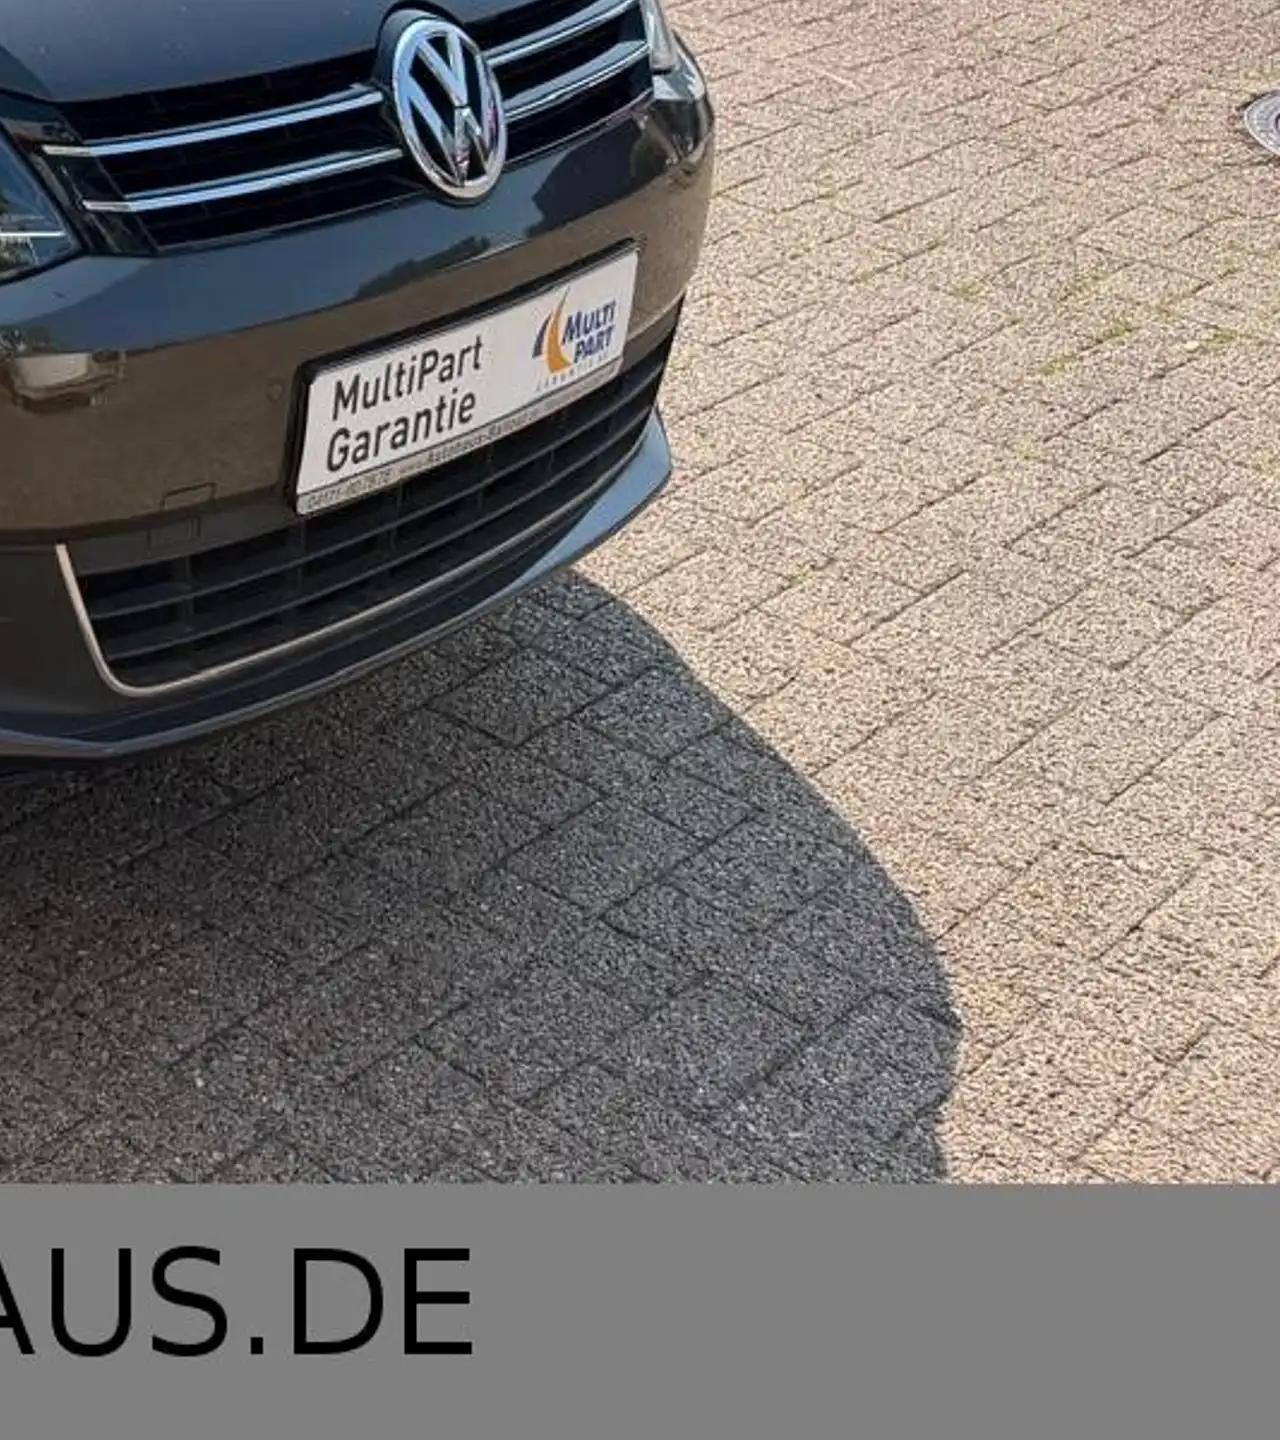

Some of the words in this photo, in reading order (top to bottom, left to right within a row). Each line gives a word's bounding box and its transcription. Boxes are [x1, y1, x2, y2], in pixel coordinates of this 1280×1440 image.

[332, 334, 484, 421] MultiPart
[573, 324, 614, 364] PART
[326, 387, 477, 472] Garantie
